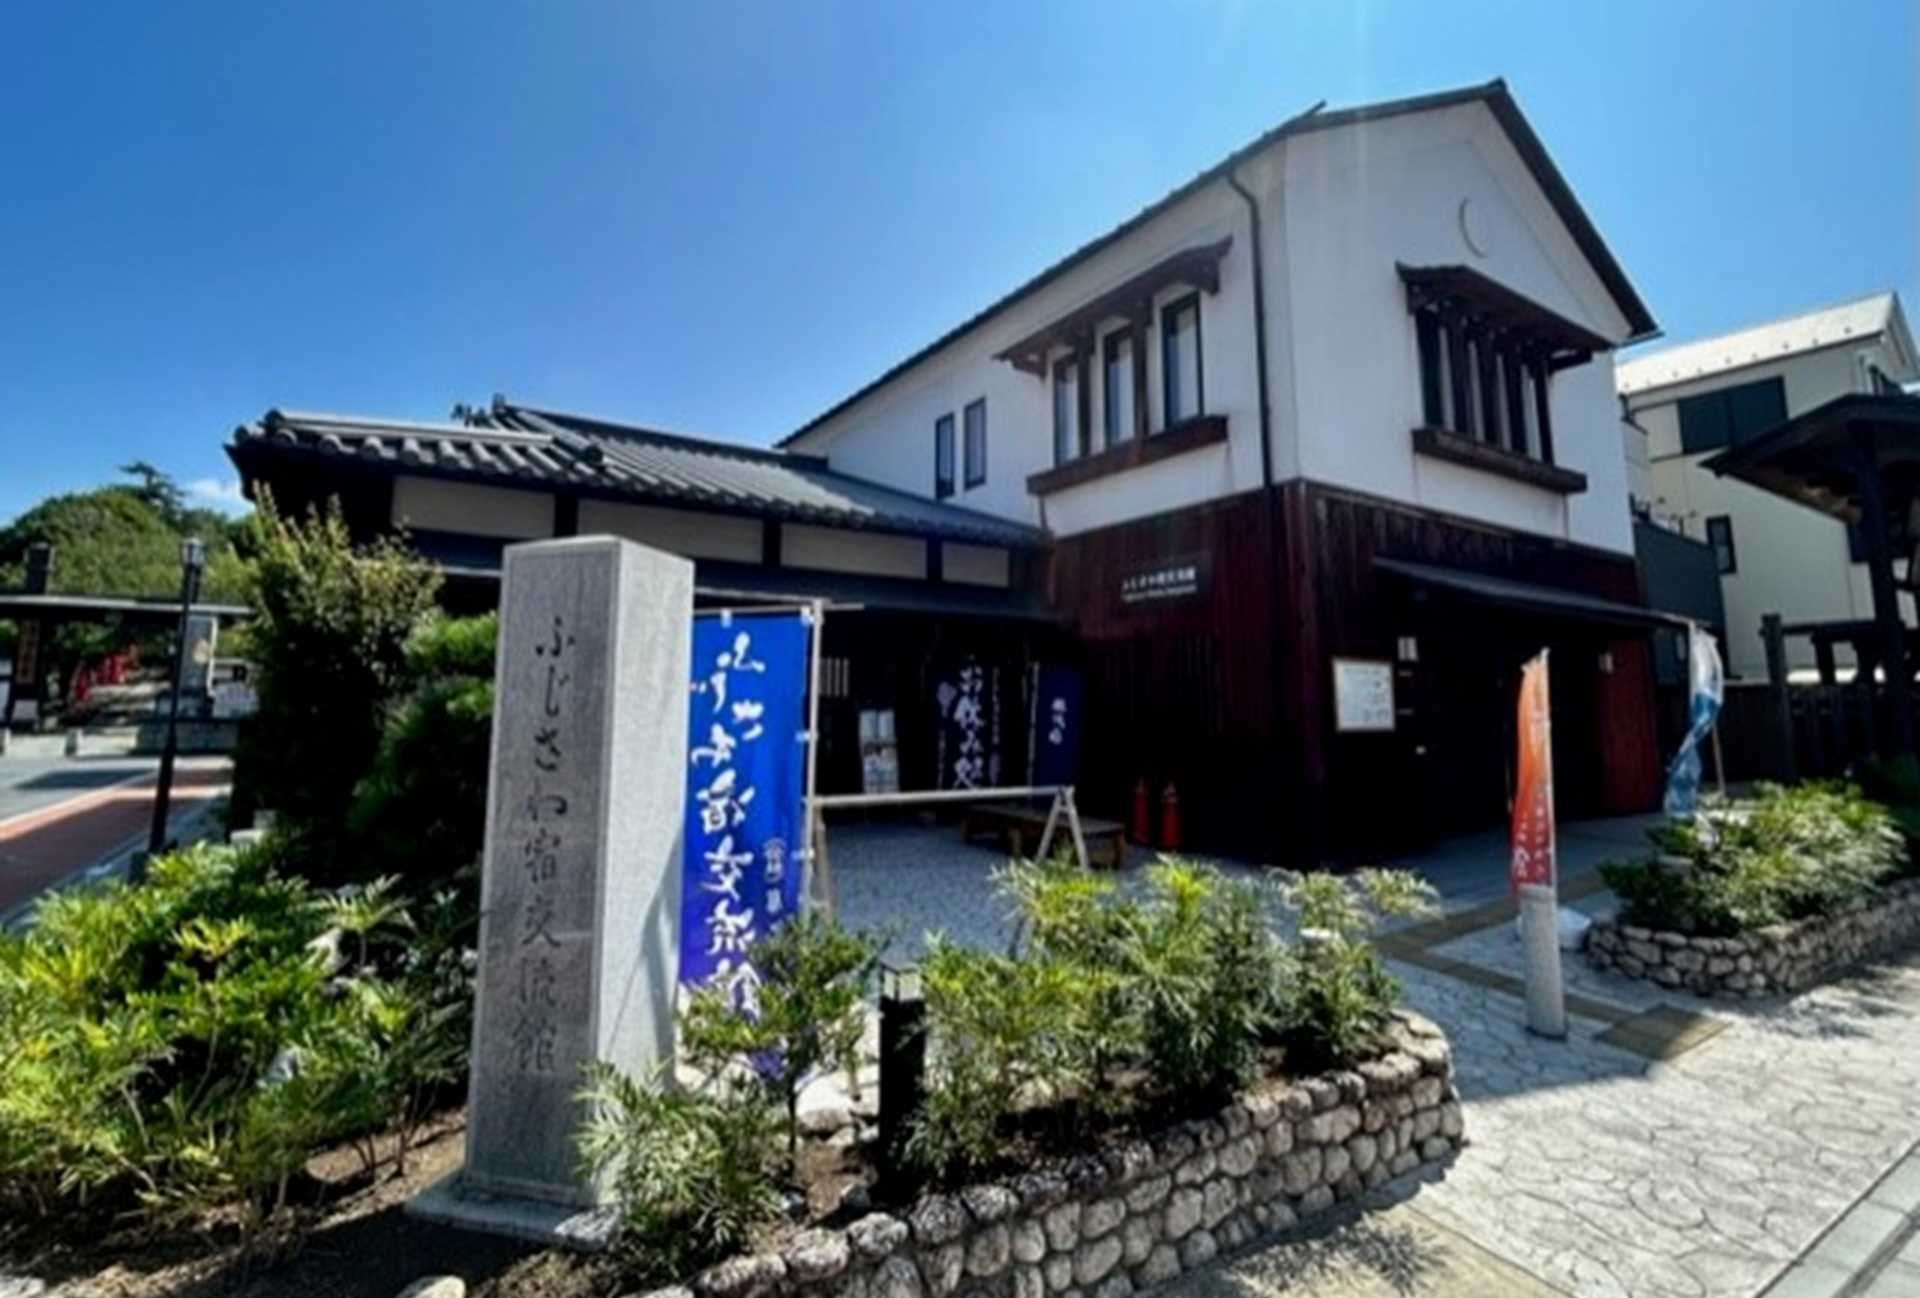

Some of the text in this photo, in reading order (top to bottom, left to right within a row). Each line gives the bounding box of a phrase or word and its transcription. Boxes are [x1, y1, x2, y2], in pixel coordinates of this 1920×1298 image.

[513, 615, 577, 1071] ふじさわ宿交流館
[952, 663, 985, 788] お休み処
